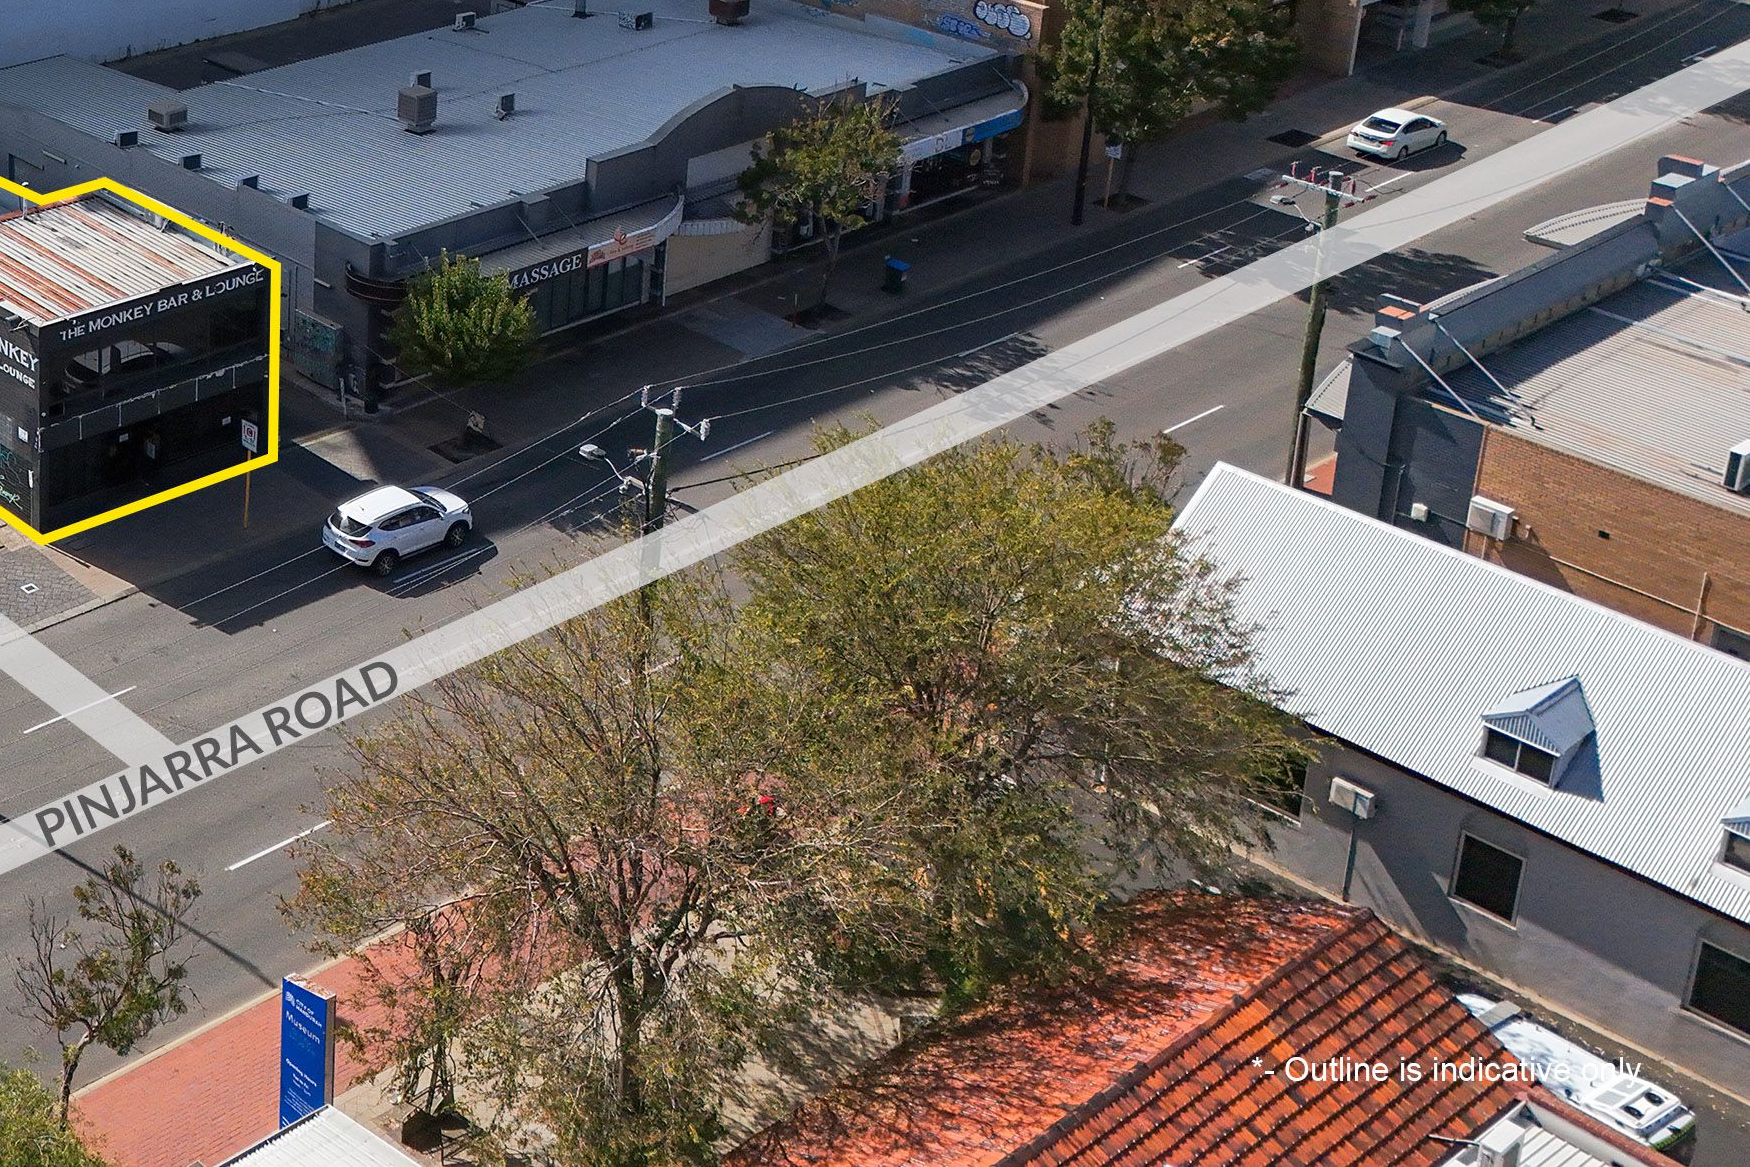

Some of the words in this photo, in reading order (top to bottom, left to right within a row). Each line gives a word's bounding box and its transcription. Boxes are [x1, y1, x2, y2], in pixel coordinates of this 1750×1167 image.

[59, 324, 86, 341] THE
[89, 302, 154, 333] MONKEY
[157, 293, 189, 313] BAR
[191, 289, 202, 301] &
[205, 268, 265, 298] LOUNGE
[286, 1010, 320, 1045] Museum
